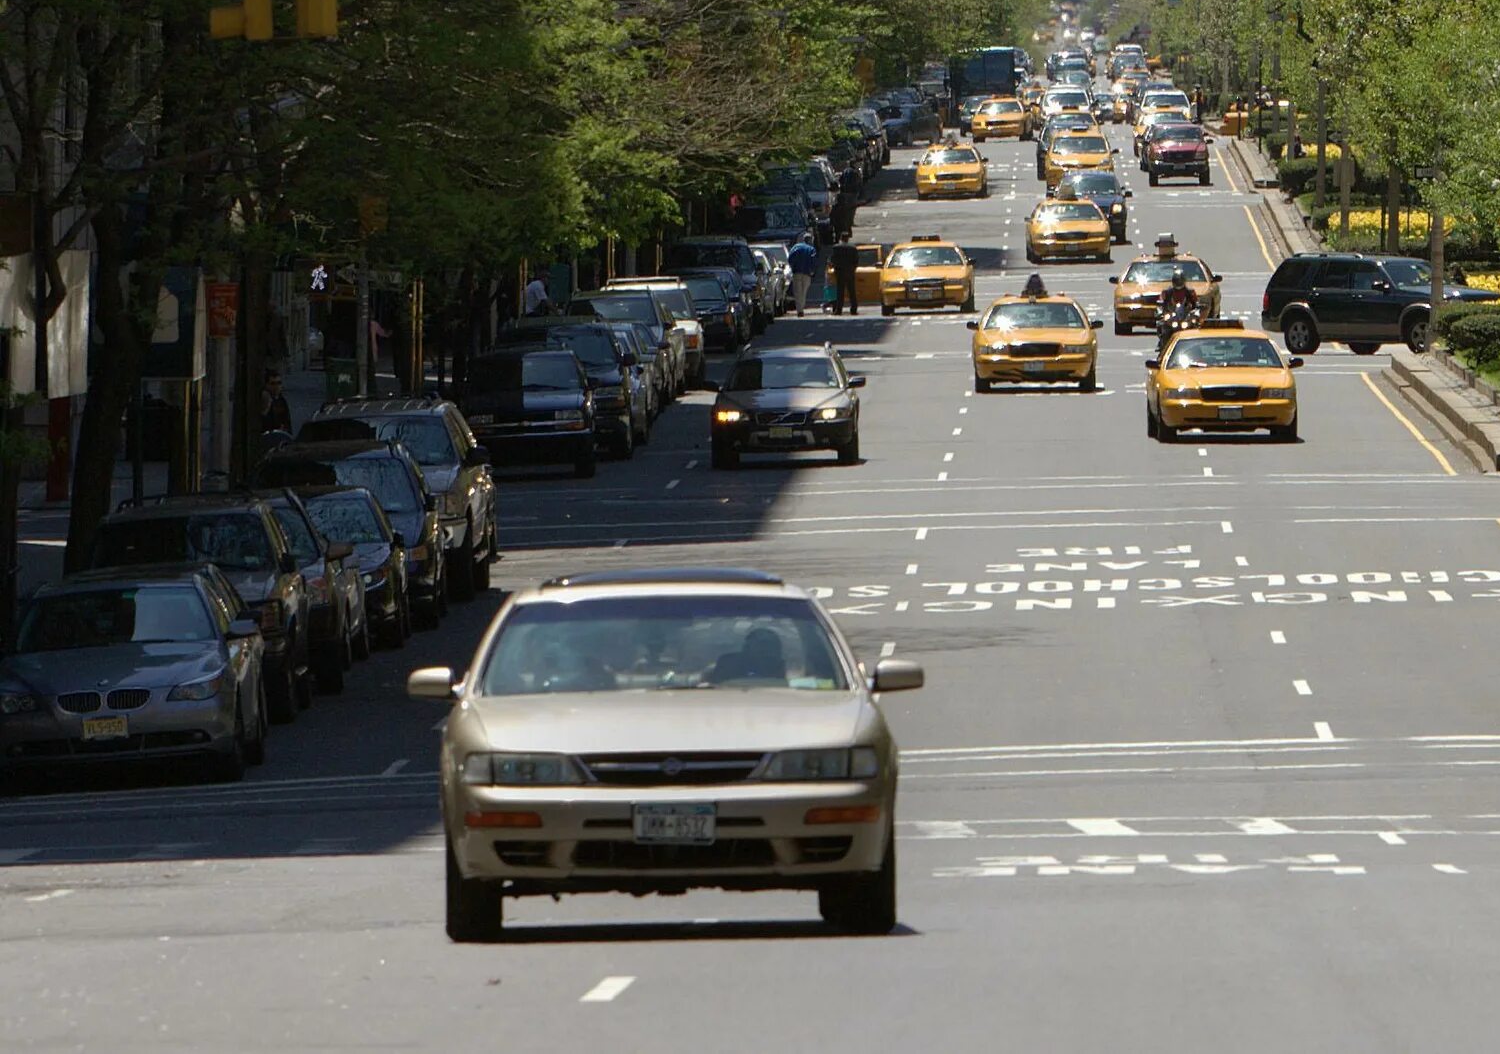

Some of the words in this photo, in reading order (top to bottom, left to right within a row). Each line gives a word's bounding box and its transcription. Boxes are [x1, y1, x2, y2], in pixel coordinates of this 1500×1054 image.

[1016, 545, 1192, 557] FIRE
[985, 559, 1200, 573] LANE
[922, 576, 1235, 595] SCHOOL
